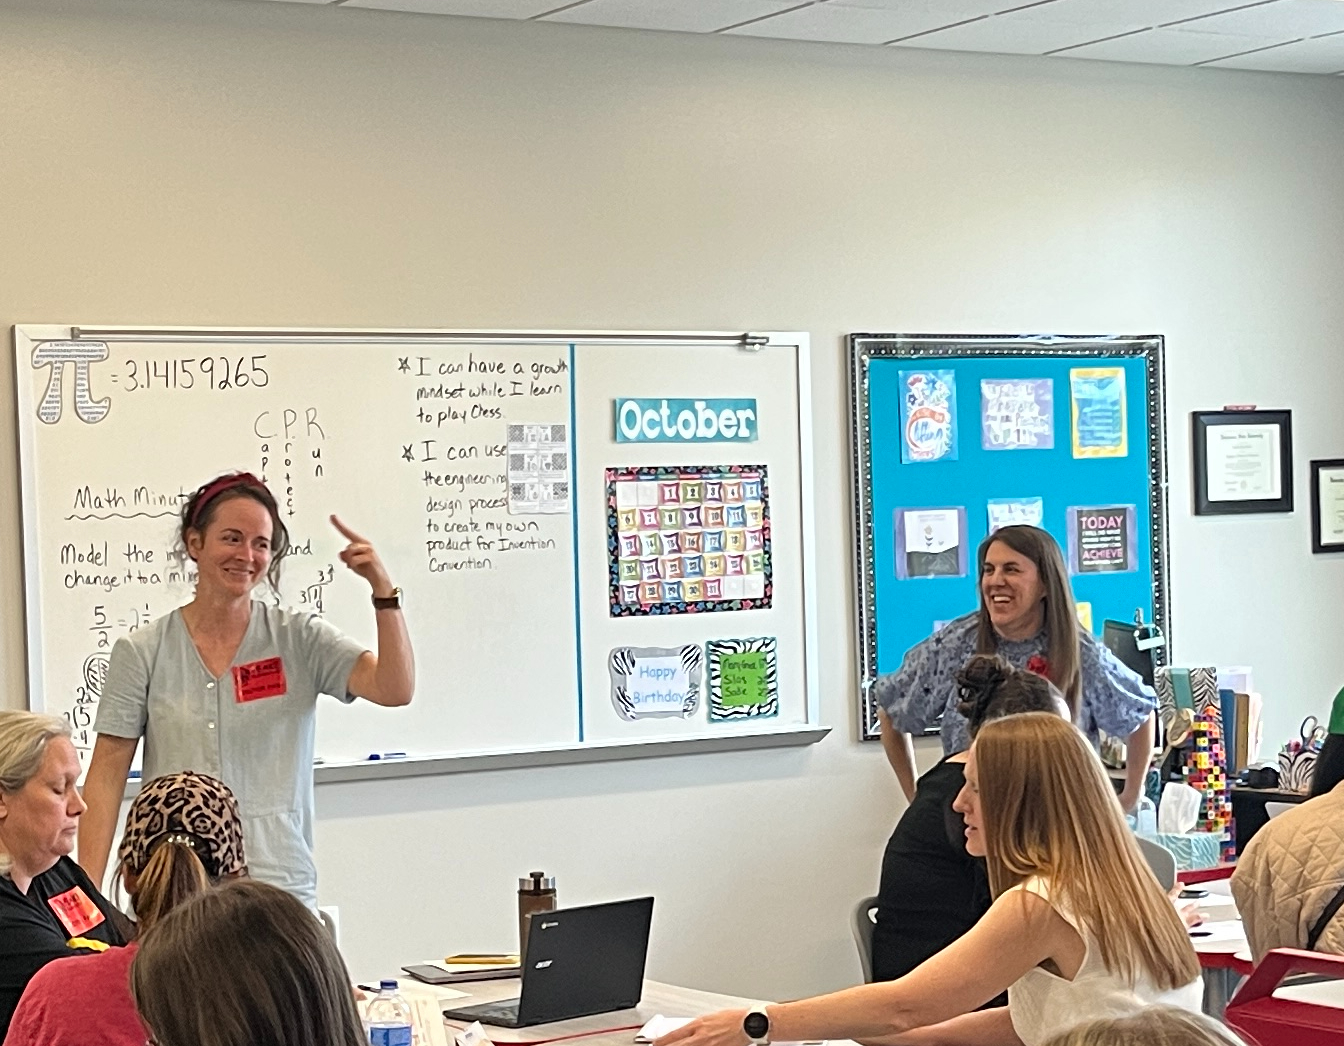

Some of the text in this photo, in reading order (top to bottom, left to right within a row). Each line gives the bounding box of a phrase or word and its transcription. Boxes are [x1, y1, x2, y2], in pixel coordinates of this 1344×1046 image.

[124, 355, 269, 392] 3.14159265
[415, 352, 569, 380] I can have a growth
[416, 381, 562, 401] mindset while I learn
[416, 407, 432, 423] to
[438, 406, 467, 428] play
[619, 400, 755, 440] October
[421, 440, 507, 462] I can use
[422, 470, 443, 487] the
[74, 485, 186, 509] Math Minut
[426, 496, 462, 518] design
[427, 517, 540, 537] to create my own
[711, 512, 720, 521] 10
[1079, 515, 1124, 530] TODAY
[426, 535, 555, 557] product for Invention
[688, 537, 696, 546] 16
[61, 541, 108, 567] Model
[123, 542, 154, 563] the
[1082, 548, 1123, 560] ACHIEVE
[64, 570, 120, 592] change
[123, 567, 132, 584] it
[137, 570, 148, 585] to
[150, 573, 161, 585] a
[640, 666, 677, 680] Happy
[633, 691, 685, 708] Birthday
